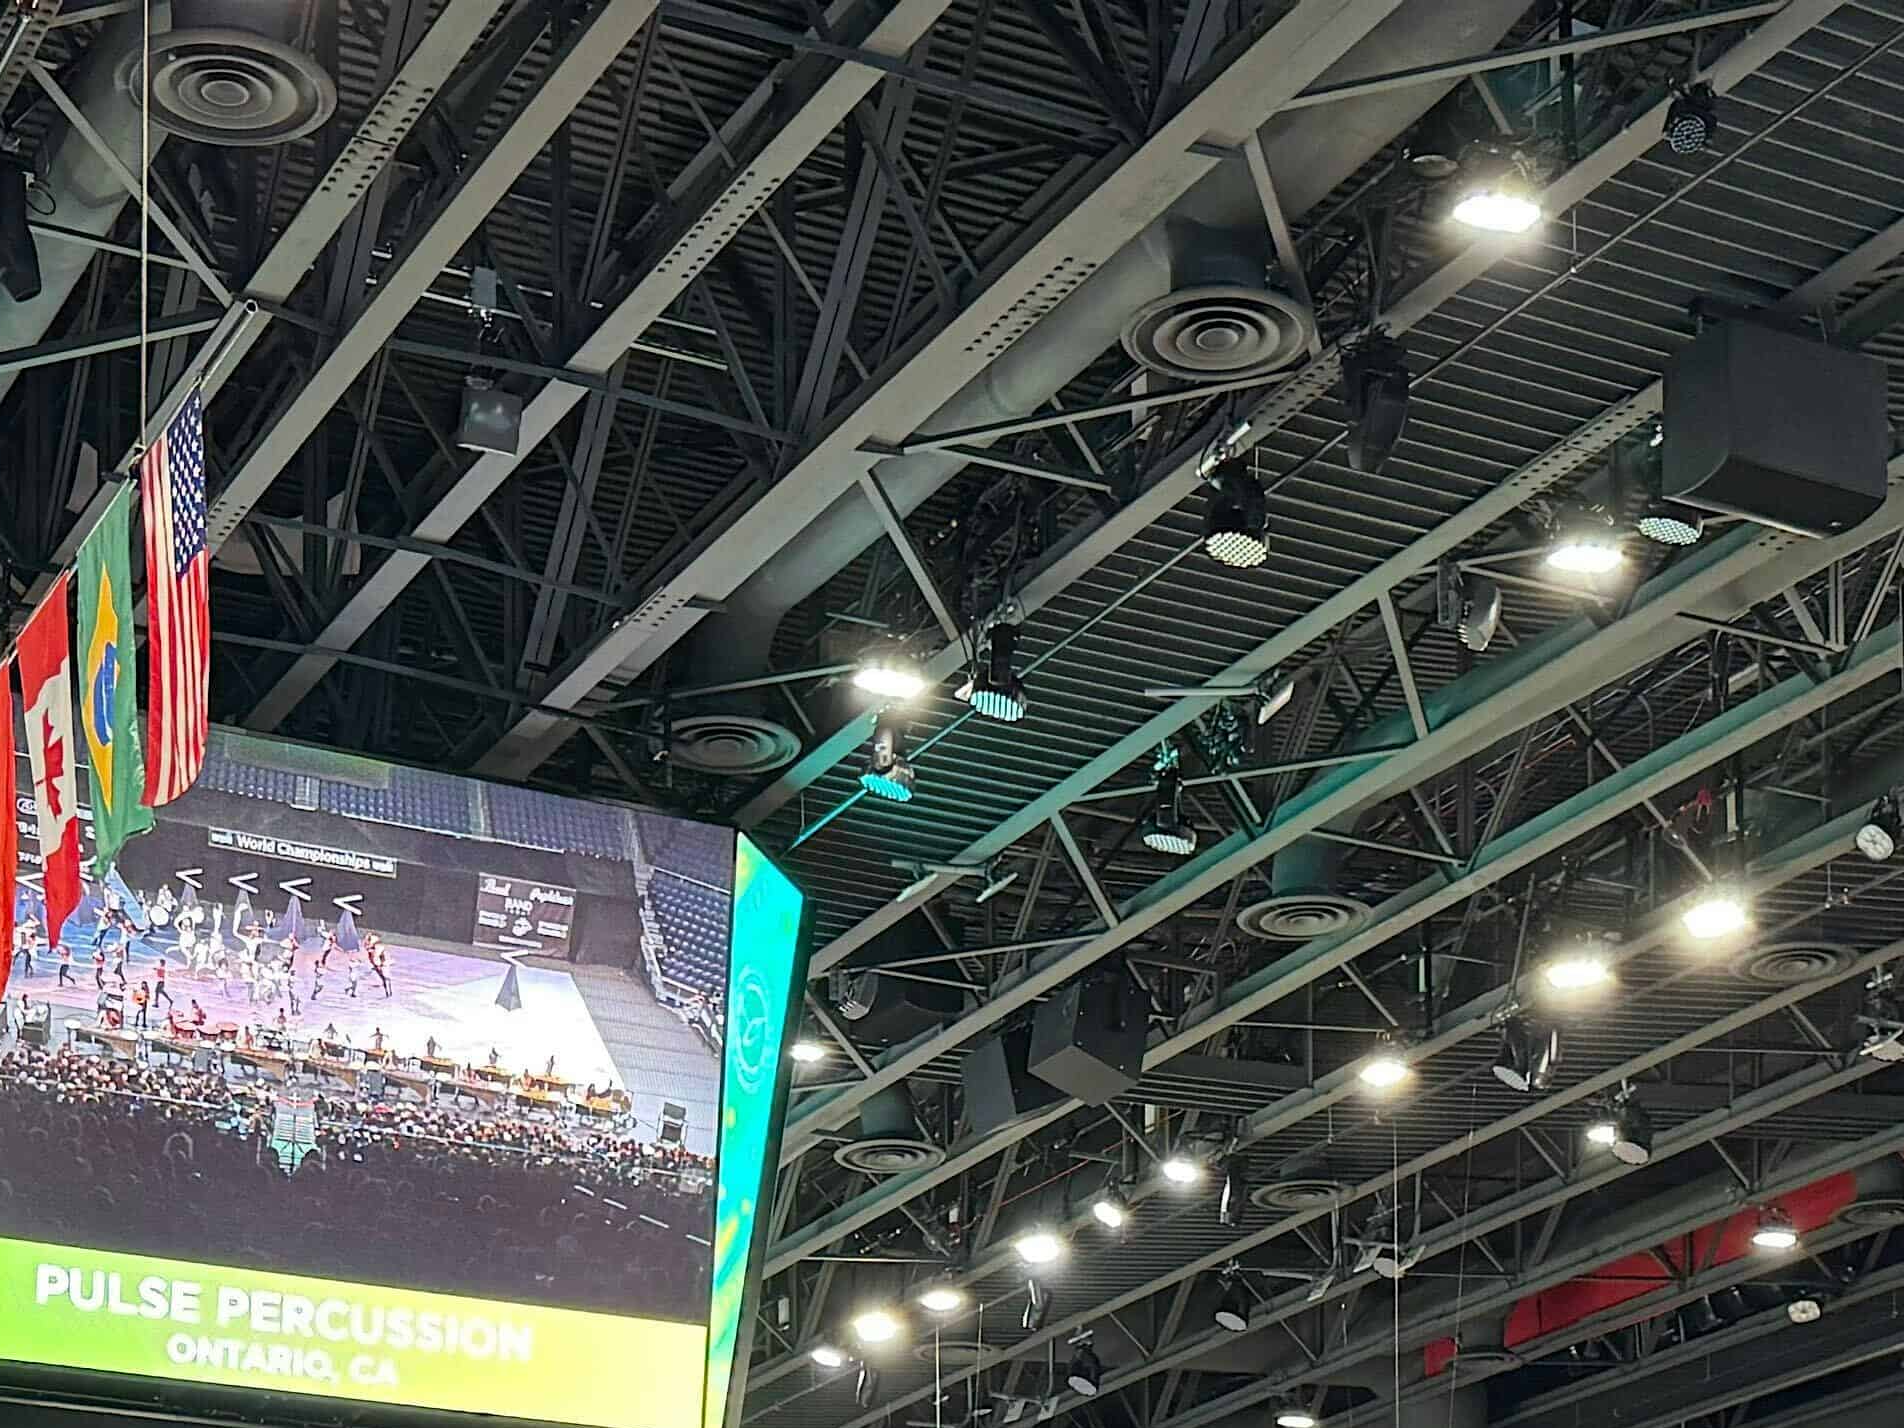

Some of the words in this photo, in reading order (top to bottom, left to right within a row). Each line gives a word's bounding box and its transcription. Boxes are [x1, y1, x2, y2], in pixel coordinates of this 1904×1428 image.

[34, 1262, 202, 1325] PULSE
[216, 1285, 533, 1362] PERCUSSION
[348, 1354, 401, 1387] CA
